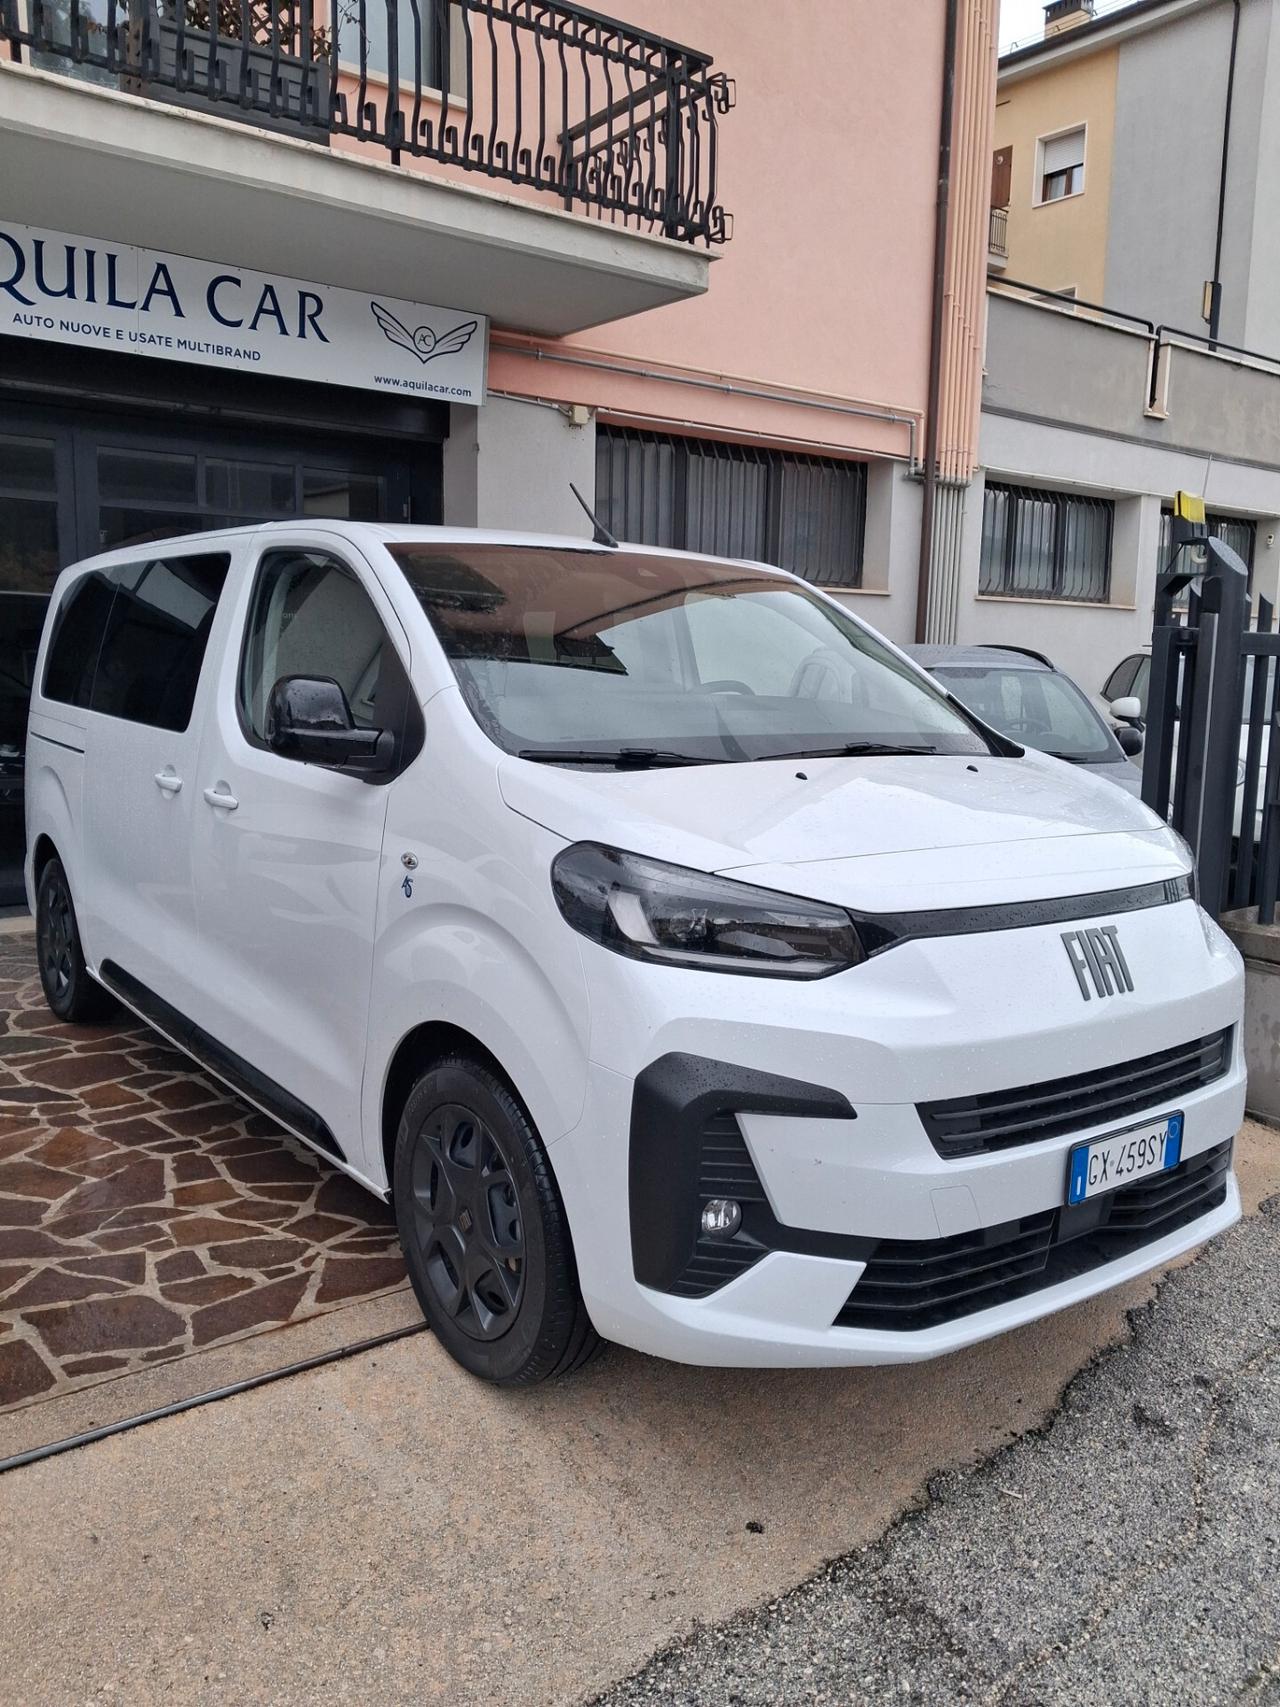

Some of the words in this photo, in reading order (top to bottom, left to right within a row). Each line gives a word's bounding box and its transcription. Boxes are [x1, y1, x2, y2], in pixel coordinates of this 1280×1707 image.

[12, 312, 55, 329] AUTO
[60, 319, 111, 338] NUOVE
[116, 329, 124, 340] E
[129, 331, 173, 348] USATE
[177, 339, 261, 361] MULTIBRAND
[206, 275, 331, 343] CAR
[374, 375, 472, 397] www.aquilacar.com
[1060, 925, 1134, 1001] FIAT
